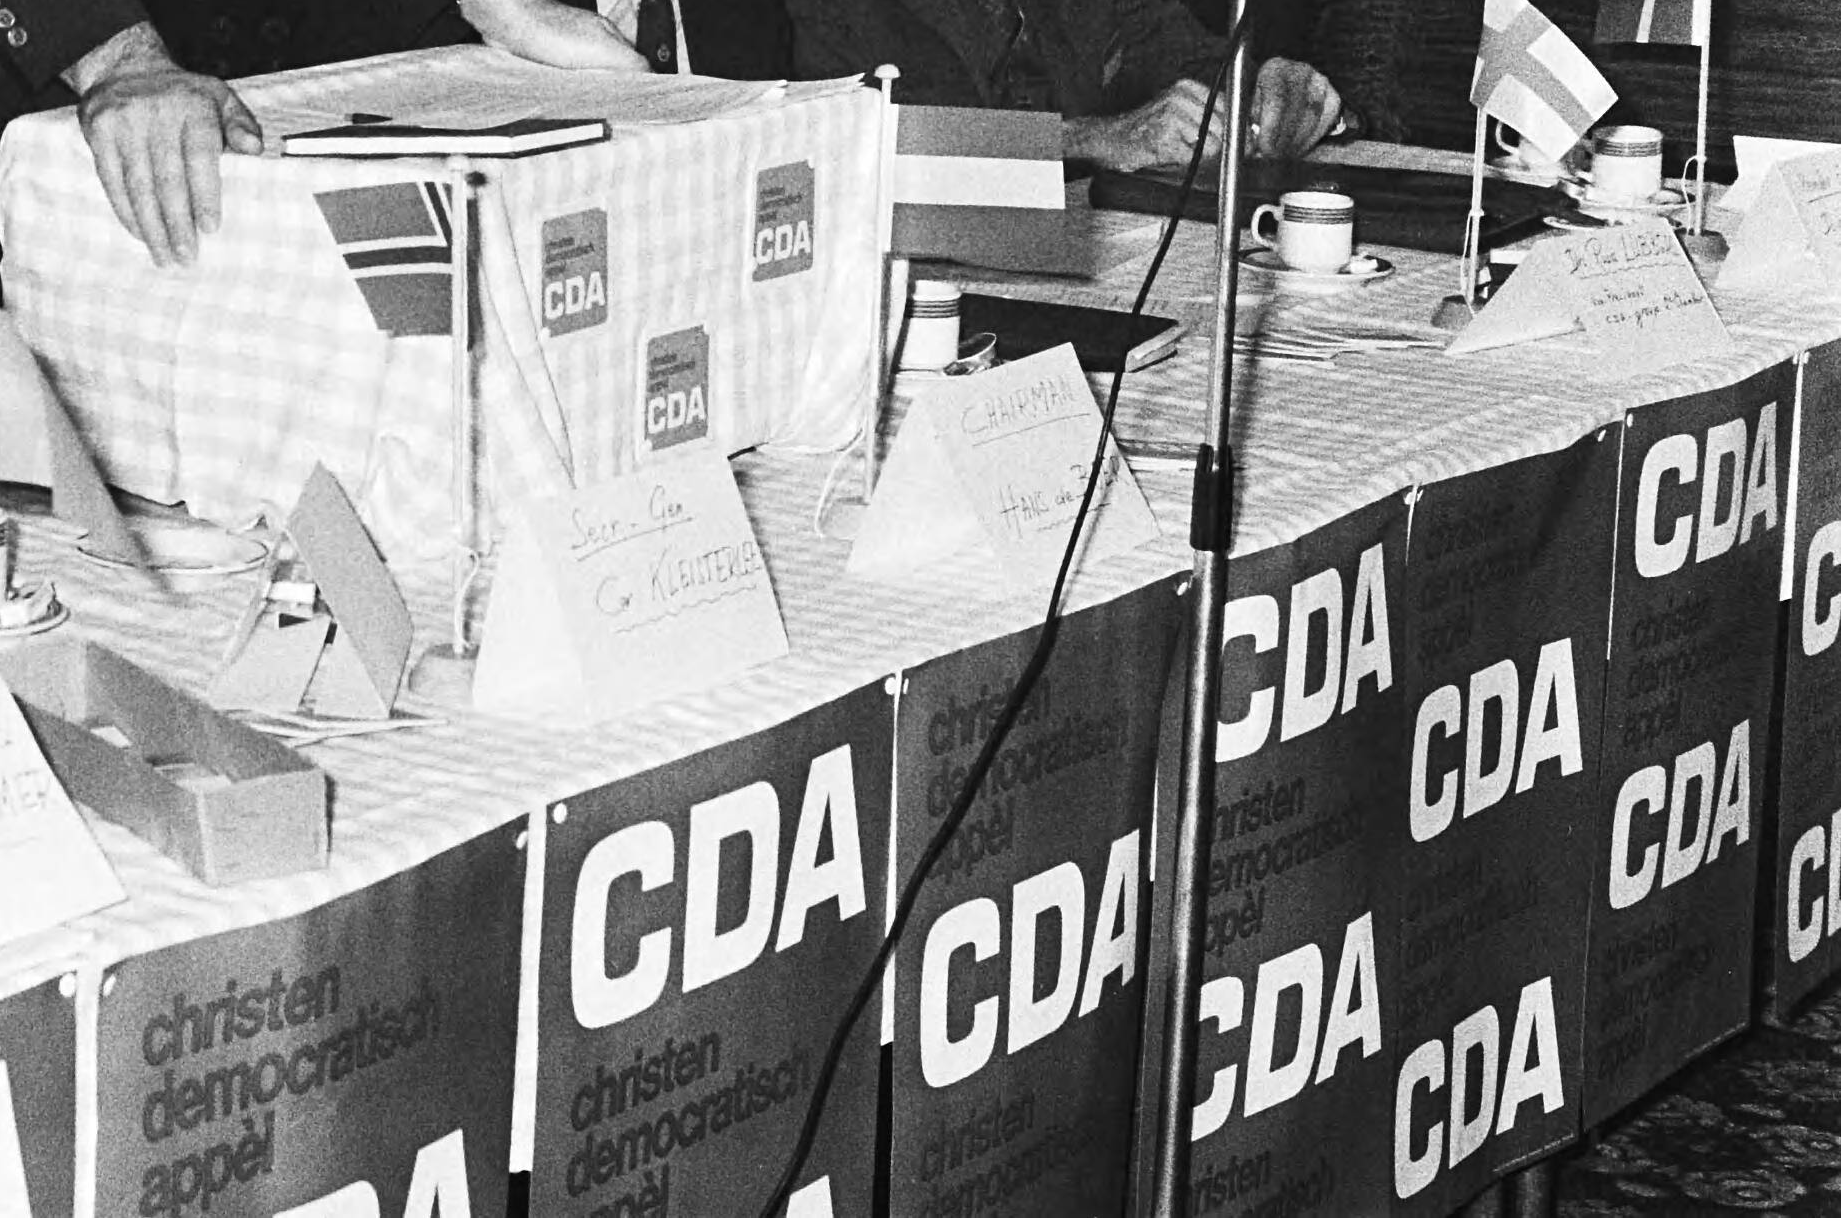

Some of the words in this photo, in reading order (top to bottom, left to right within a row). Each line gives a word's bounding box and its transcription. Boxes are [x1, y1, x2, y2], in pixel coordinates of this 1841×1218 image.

[545, 271, 605, 320] CDA
[756, 220, 811, 264] CDA
[648, 385, 706, 434] CDA
[1635, 402, 1778, 579] CDA
[1216, 544, 1392, 763] CDA
[1410, 638, 1584, 843] CDA
[571, 745, 866, 1029] CDA
[1609, 719, 1751, 910] CDA
[142, 965, 341, 1067] christen
[920, 829, 1140, 1088] CDA
[1191, 912, 1382, 1142] CDA
[142, 976, 440, 1143] democratisch
[566, 1043, 809, 1198] democratisch
[571, 1032, 721, 1132] christen
[1395, 977, 1565, 1199] CDA
